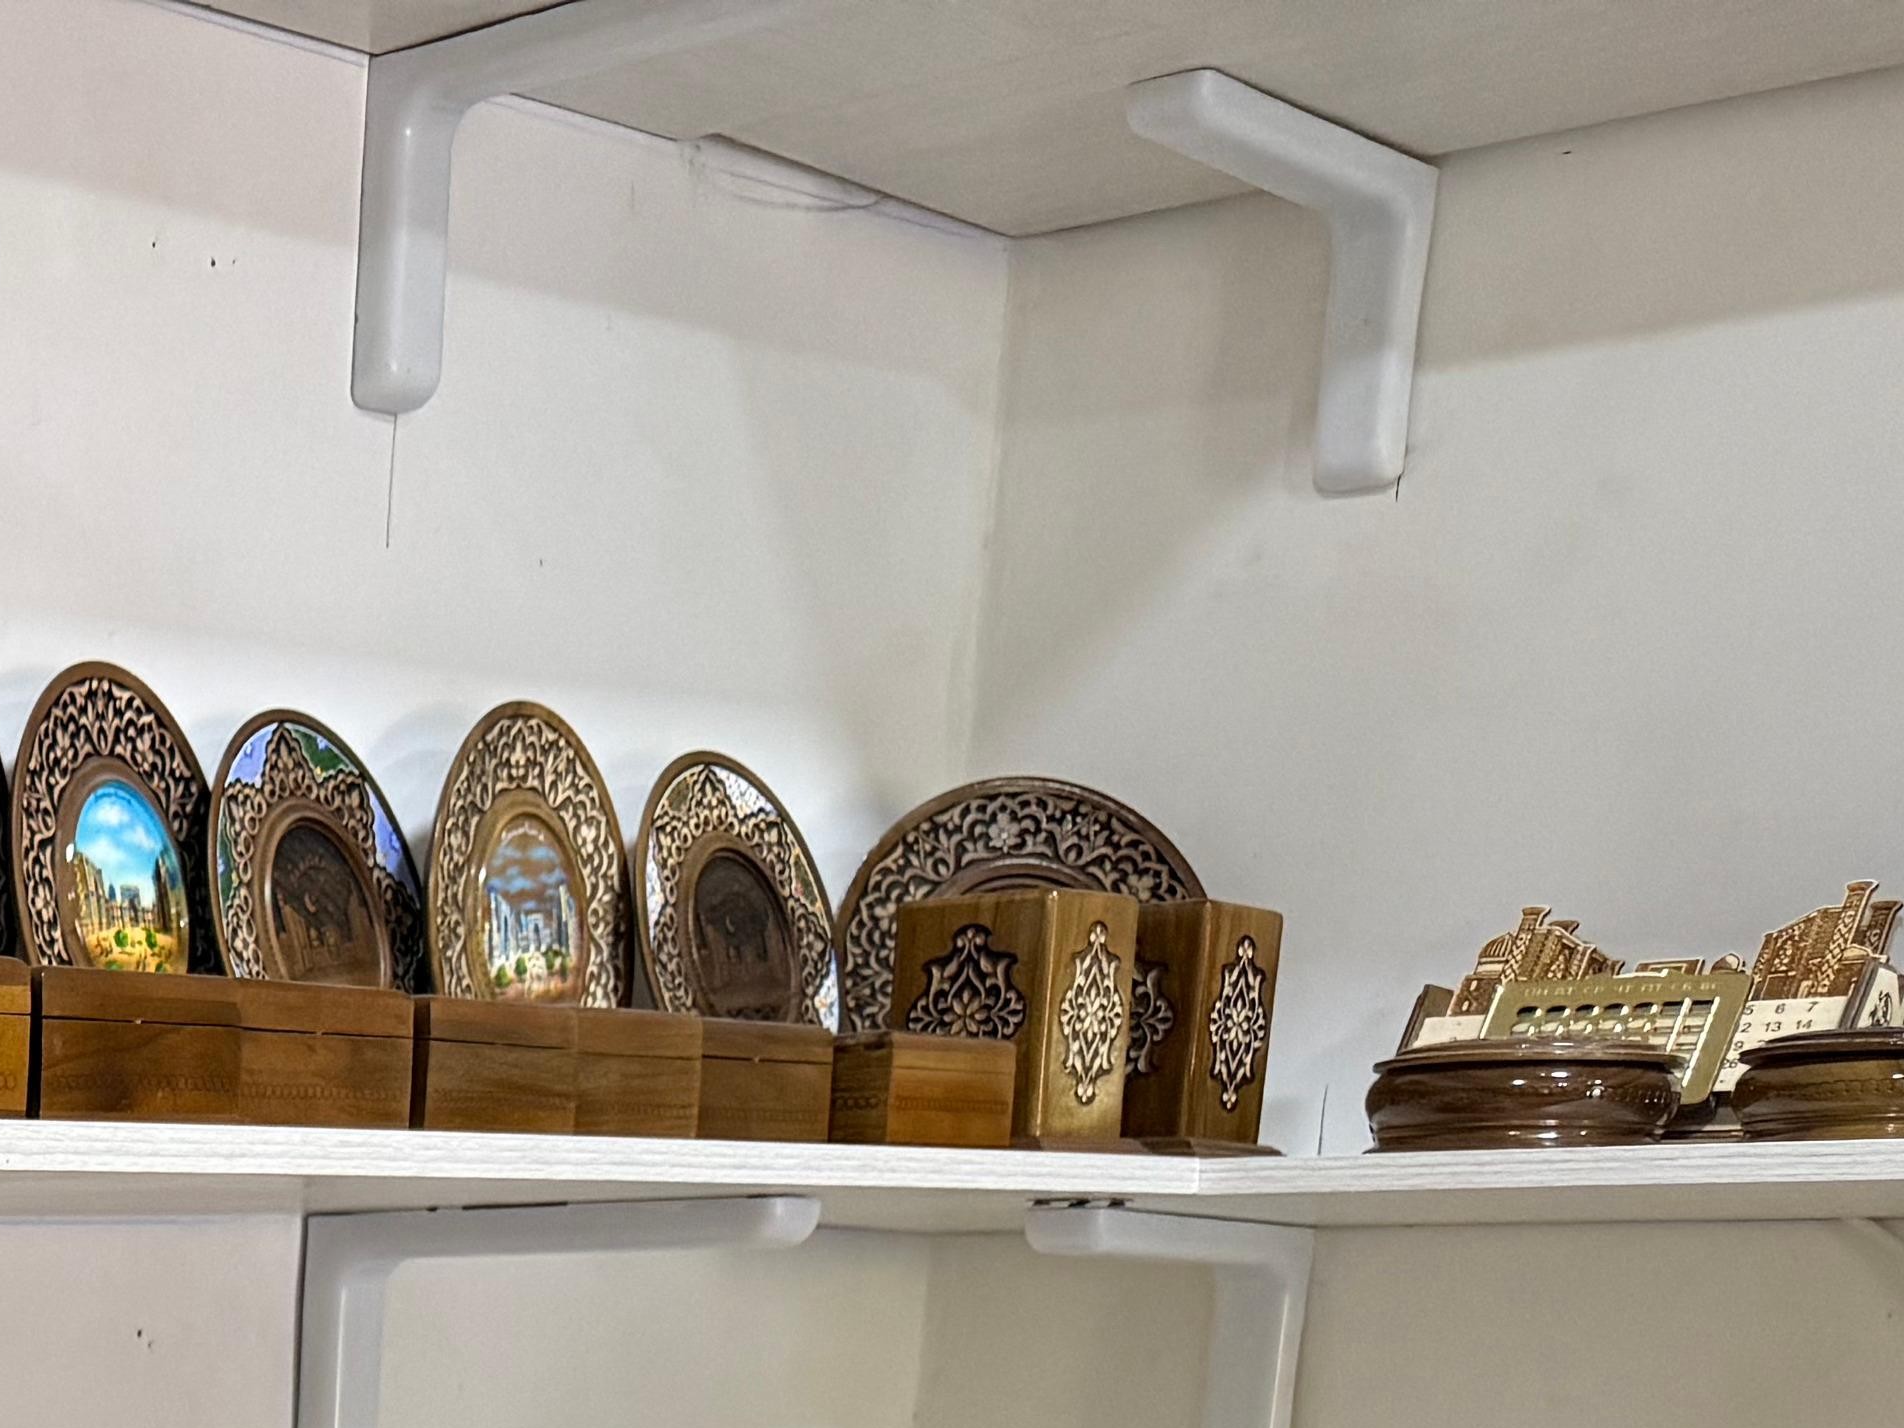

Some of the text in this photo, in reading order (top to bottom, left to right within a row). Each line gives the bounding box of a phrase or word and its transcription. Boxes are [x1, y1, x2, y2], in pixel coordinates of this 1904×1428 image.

[1775, 1002, 1786, 1014] 6
[1807, 1001, 1819, 1013] 7
[1740, 1019, 1814, 1033] 2 13 14
[1733, 1041, 1744, 1051] 9
